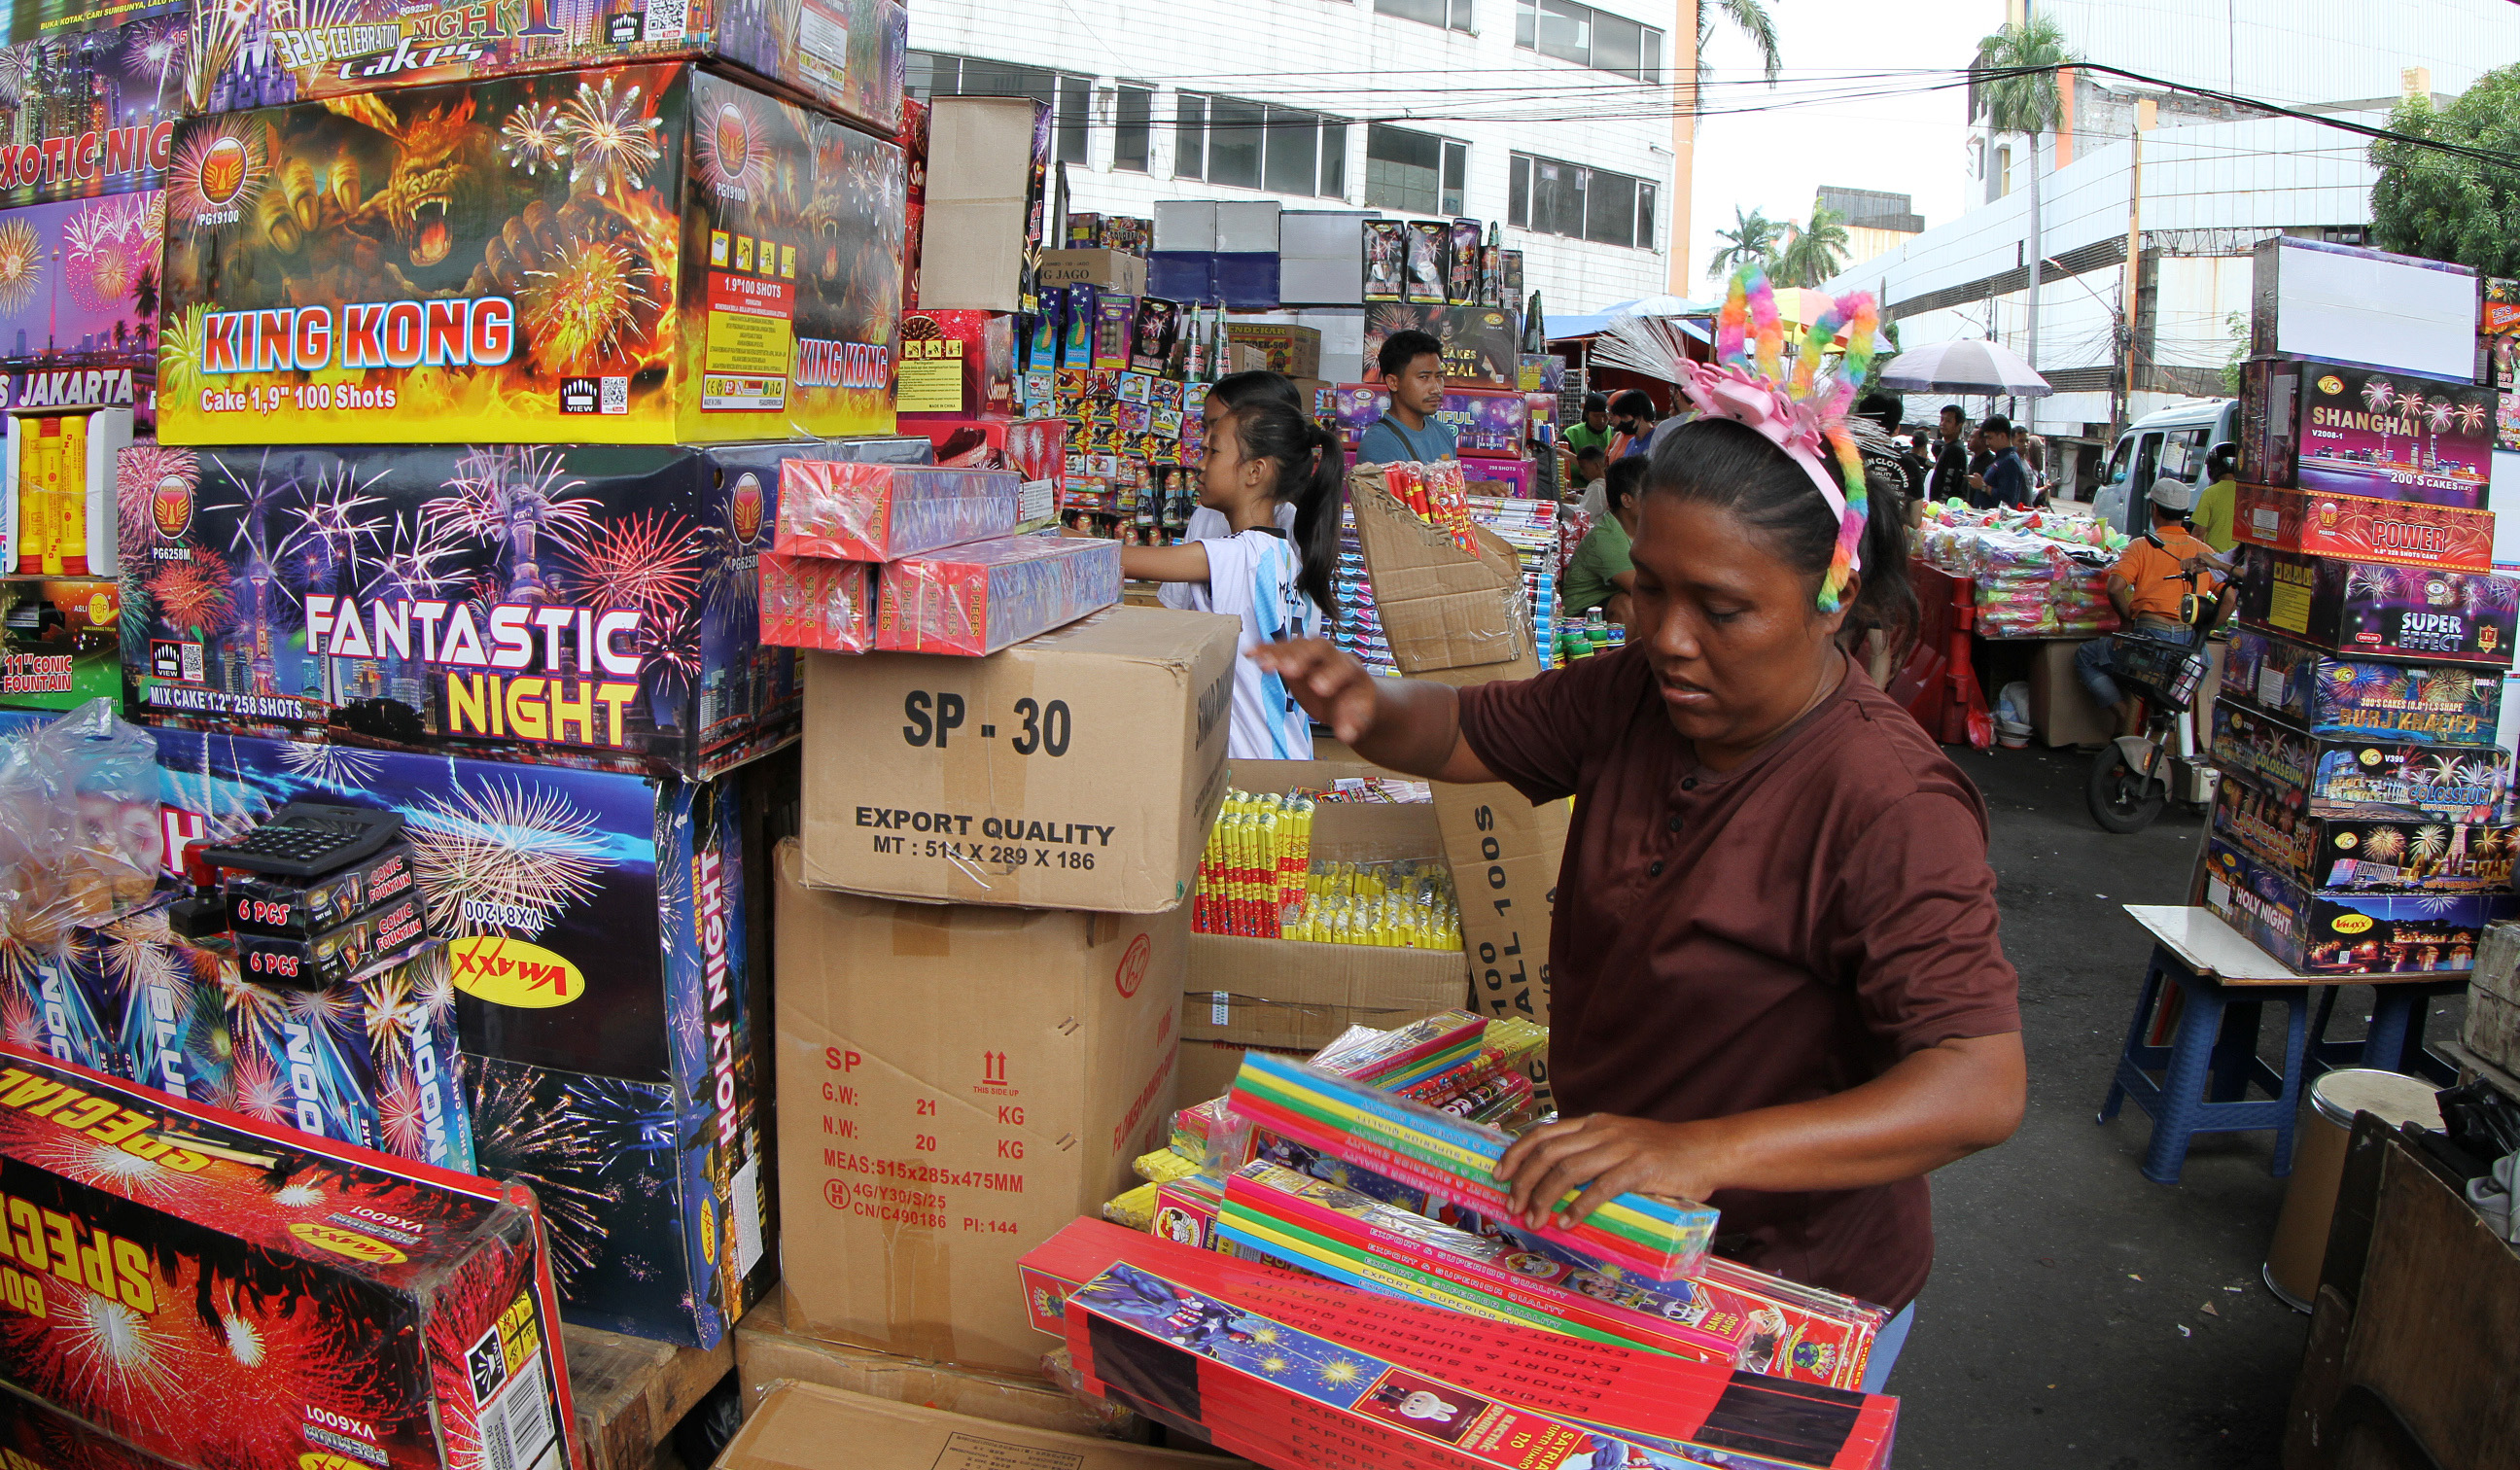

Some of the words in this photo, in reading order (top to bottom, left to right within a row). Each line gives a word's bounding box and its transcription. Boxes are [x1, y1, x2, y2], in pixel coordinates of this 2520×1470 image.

[40, 20, 58, 30] BUKA
[59, 14, 85, 26] KOTAK,
[86, 11, 103, 20] CARI
[103, 2, 146, 17] SUMBUNYA,
[400, 3, 434, 16] PG92321
[412, 0, 565, 41] NIGHT
[173, 30, 188, 45] 15
[339, 35, 488, 80] cakes
[0, 131, 96, 191] XOTIC
[716, 182, 746, 202] PG19100
[198, 210, 239, 227] PG19100
[1109, 230, 1142, 241] COLORFUL
[755, 282, 782, 298] SHOTS
[1056, 269, 1089, 281] JAGO
[201, 307, 332, 373] KING
[341, 298, 514, 368] KONG
[1228, 326, 1286, 335] ENDEKAR
[797, 337, 842, 386] KING
[842, 341, 889, 389] KONG
[18, 368, 134, 406] JAKARTA
[201, 387, 246, 412] Cake
[294, 386, 329, 409] 100
[334, 384, 398, 410] Shots
[2312, 406, 2421, 438] SHANGHAI
[2312, 429, 2343, 440] V2008-1
[1874, 457, 1909, 488] CLOTHING
[2390, 472, 2425, 486] 200'S
[2426, 478, 2459, 491] CAKES
[2371, 520, 2446, 554] POWER
[153, 547, 191, 561] PG6258M
[2399, 550, 2422, 559] SHOTS
[2422, 551, 2439, 561] CAKE
[764, 574, 773, 614] PIECES
[806, 576, 815, 617] PIECES
[902, 591, 912, 632] PIECES
[970, 593, 980, 637] PIECES
[2401, 612, 2463, 634] SUPER
[304, 594, 644, 676] FANTASTIC
[2398, 630, 2465, 653] EFFECT
[33, 654, 73, 674] CONIC
[158, 669, 178, 678] VIEW
[3, 674, 72, 694] FOUNTAIN
[150, 685, 172, 707] MIX
[173, 688, 206, 711] CAKE
[234, 694, 257, 716] 258
[259, 696, 303, 719] SHOTS
[447, 672, 638, 748] NIGHT
[2361, 697, 2381, 708] 300'S
[2382, 699, 2406, 710] CAKES
[2439, 703, 2464, 713] SHAPE
[903, 690, 965, 748] SP
[1012, 697, 1071, 757] 30
[2338, 708, 2395, 729] BURJ
[2398, 711, 2478, 734] KHALIFA
[2256, 751, 2303, 785] COLOSSEUM
[2384, 754, 2405, 763] V399
[2406, 784, 2492, 806] COLOSSEUM
[856, 806, 972, 835] EXPORT
[982, 817, 1115, 847] QUALITY
[2251, 815, 2292, 858] VEGAS
[873, 834, 905, 855] MT
[925, 840, 962, 859] 514
[968, 844, 984, 862] X
[990, 845, 1028, 865] 289
[1033, 850, 1050, 867] X
[1056, 851, 1096, 870] 186
[371, 856, 402, 887] CONIC
[368, 871, 411, 903] FOUNTAIN
[239, 899, 251, 921] 6
[254, 900, 290, 926] PCS
[379, 902, 414, 935] CONIC
[465, 900, 544, 931] VX81200
[695, 902, 705, 945] 1200
[2236, 886, 2259, 916] HOLY
[2258, 900, 2292, 936] NIGHT
[375, 918, 423, 952] FOUNTAIN
[700, 849, 728, 1012] NIGHT
[250, 951, 262, 971] 6
[265, 953, 298, 977] PCS
[1479, 941, 1507, 1017] 100
[825, 1046, 862, 1073] SP
[409, 1002, 449, 1164] MOON
[716, 1020, 739, 1148] HOLY
[822, 1081, 858, 1106] G.W:
[972, 1085, 989, 1094] THIS
[1008, 1088, 1019, 1097] UP
[916, 1099, 936, 1116] 21
[998, 1104, 1025, 1125] KG
[822, 1114, 858, 1139] N.W:
[915, 1134, 936, 1152] 20
[998, 1138, 1024, 1159] KG
[852, 1184, 947, 1209] 4G/Y30/S/25
[328, 1212, 422, 1245] PREMIUM
[349, 1204, 424, 1233] VX6001
[854, 1201, 947, 1229] CN/C490186
[963, 1217, 985, 1234] PI:
[989, 1219, 1018, 1235] 144
[1369, 1227, 1420, 1250] EXPORT
[1437, 1251, 1506, 1280] SUPERIOR
[1367, 1242, 1418, 1266] EXPORT
[1435, 1267, 1503, 1296] SUPERIOR
[1507, 1291, 1566, 1315] QUALITY
[1239, 1290, 1336, 1321] QUALITY
[1251, 1279, 1348, 1309] QUALITY
[1345, 1317, 1474, 1355] SUPERIOR
[1357, 1306, 1485, 1343] SUPERIOR
[1703, 1311, 1728, 1333] BANG
[1718, 1313, 1739, 1336] JAGO
[1508, 1359, 1613, 1387] EXPORT
[1518, 1347, 1623, 1374] EXPORT
[306, 1404, 376, 1441] VX6001
[1290, 1398, 1391, 1441] EXPORT
[1459, 1403, 1506, 1452] SPARKLERS
[1477, 1413, 1519, 1453] ELECTRIC
[1540, 1422, 1562, 1447] SUPER
[302, 1422, 390, 1467] PREMIUM
[1509, 1430, 1533, 1450] 120
[1533, 1430, 1576, 1470] SATRIA
[1518, 1443, 1545, 1470] JUMBO
